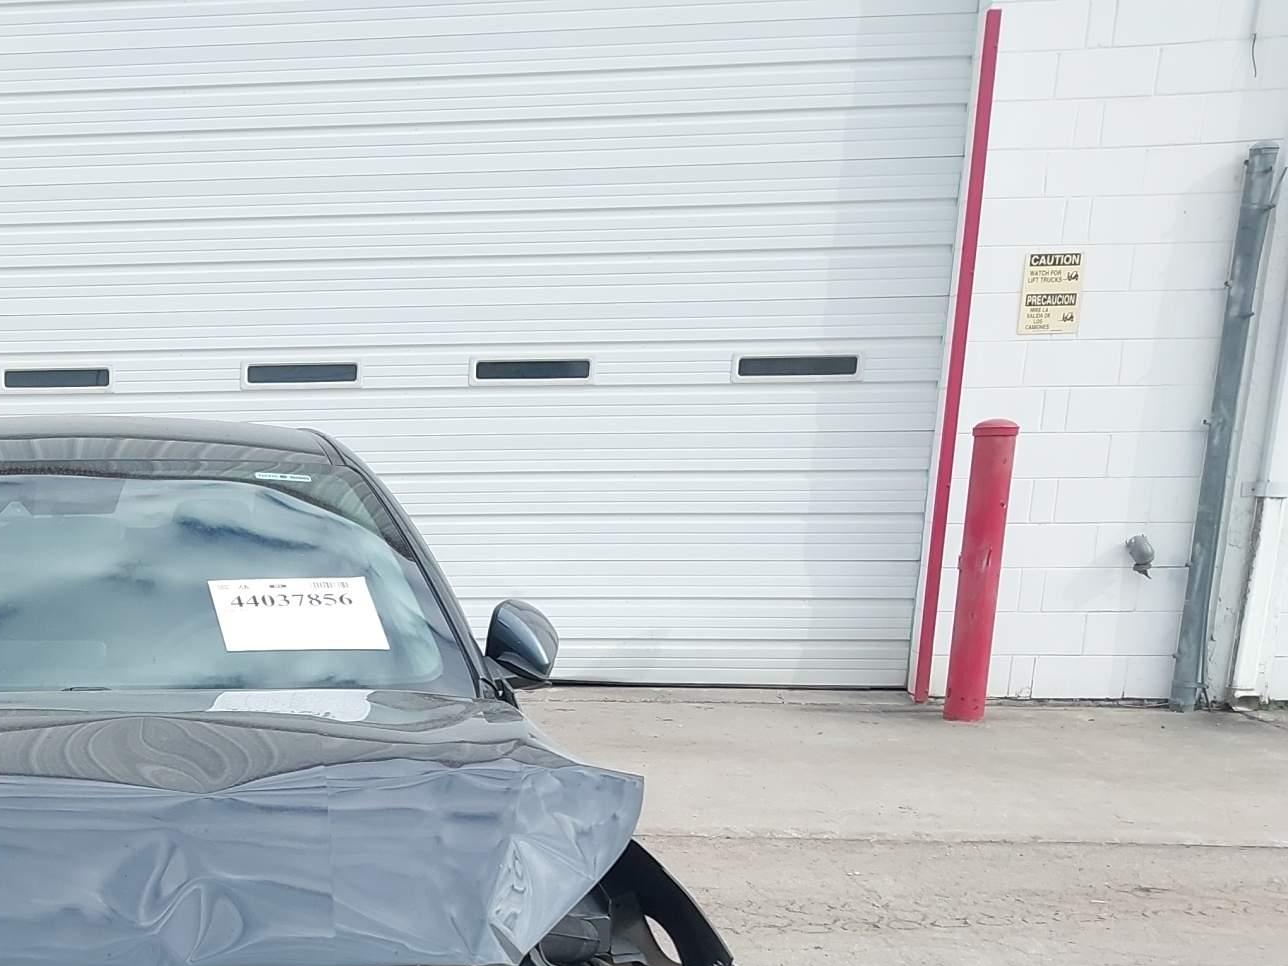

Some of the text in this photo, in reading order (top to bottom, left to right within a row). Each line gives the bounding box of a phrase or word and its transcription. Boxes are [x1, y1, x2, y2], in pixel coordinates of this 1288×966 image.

[1031, 254, 1080, 265] CAUTION
[1026, 294, 1075, 305] PRECAUCION
[230, 593, 353, 608] 44037856
